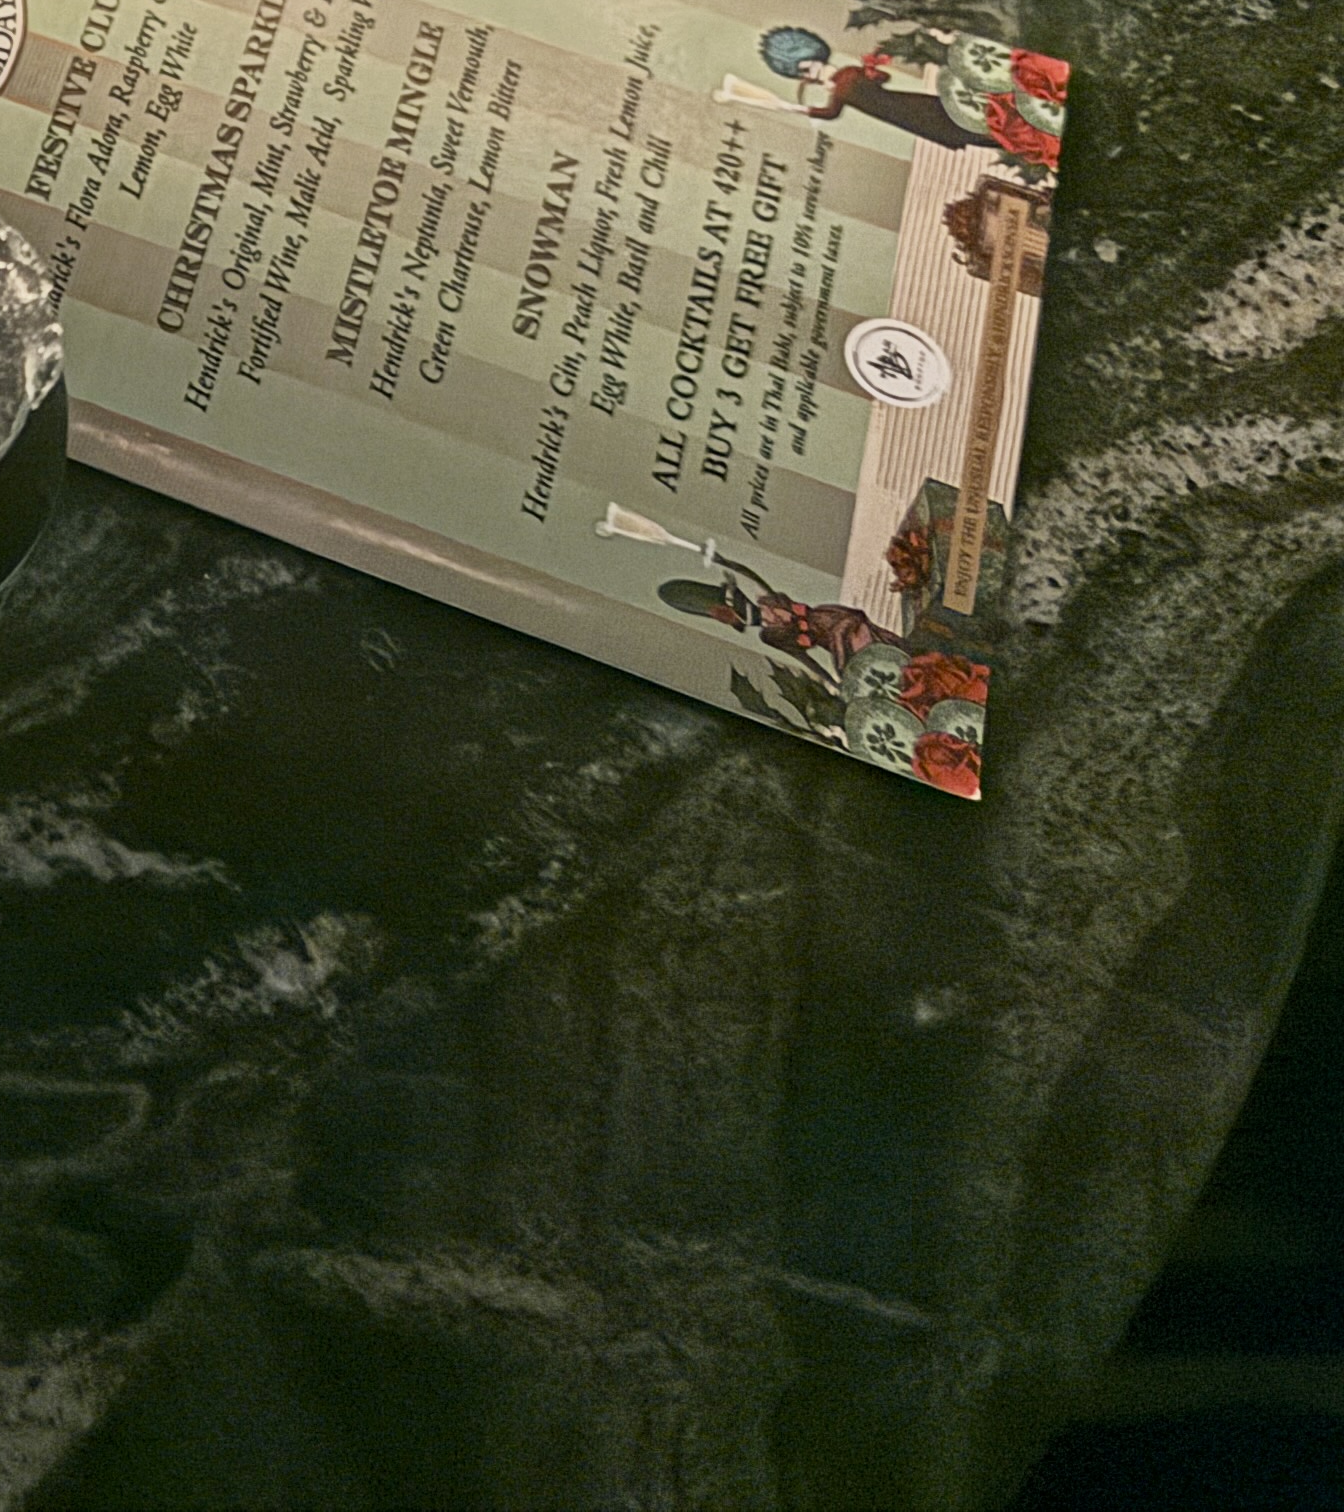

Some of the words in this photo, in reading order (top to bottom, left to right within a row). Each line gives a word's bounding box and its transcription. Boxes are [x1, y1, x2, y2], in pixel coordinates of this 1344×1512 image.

[302, 6, 327, 28] &
[107, 8, 167, 107] Raspberry
[157, 21, 198, 81] White
[321, 10, 376, 103] Sparkling
[444, 24, 495, 114] Vermouth,
[622, 23, 661, 81] Juice,
[143, 82, 184, 123] Egg
[268, 32, 328, 137] Strawberry
[486, 58, 523, 122] Bitters
[607, 75, 644, 142] Lemon
[23, 55, 97, 201] FESTIVE
[86, 112, 131, 176] Adora,
[304, 114, 343, 168] Acid,
[429, 116, 465, 177] Sweet
[711, 119, 747, 195] 420++
[805, 129, 834, 174] charge
[117, 128, 167, 200] Lemon,
[249, 142, 292, 198] Mint,
[466, 125, 506, 195] Lemon
[593, 146, 628, 203] Fresh
[751, 151, 787, 223] GIFT
[63, 176, 102, 231] Flora
[283, 167, 322, 228] Malic
[324, 155, 407, 368] MISTLETOE
[384, 20, 445, 155] MINGLE
[634, 191, 660, 235] and
[701, 198, 732, 245] AT
[801, 174, 822, 222] service
[155, 122, 244, 333] CHRISTMAS
[220, 201, 274, 291] Original,
[399, 182, 454, 282] Neptunia,
[436, 200, 492, 313] Chartreuse,
[511, 149, 580, 340] SNOWMAN
[575, 206, 620, 278] Liquor,
[790, 223, 814, 258] 10%
[821, 224, 844, 263] taxes.
[262, 233, 309, 294] Wine,
[616, 235, 651, 294] Basil
[735, 228, 773, 308] FREE
[789, 261, 807, 278] to
[560, 282, 597, 345] Peach
[665, 246, 724, 422] COCKTAILS
[779, 277, 804, 329] subject
[809, 263, 836, 351] government
[182, 297, 238, 413] Hendrick's
[235, 292, 283, 386] Fortified
[368, 284, 421, 400] Hendrick's
[418, 319, 456, 385] Green
[598, 301, 642, 370] White,
[720, 311, 756, 379] GET
[768, 332, 798, 372] Baht,
[548, 351, 587, 398] Gin,
[588, 372, 628, 417] Egg
[715, 387, 742, 406] 3
[760, 371, 786, 412] Thai
[793, 348, 821, 423] applicable
[700, 407, 738, 482] BUY
[758, 414, 779, 433] in
[758, 434, 775, 460] are
[786, 421, 808, 456] and
[520, 405, 569, 523] Hendrick's
[650, 431, 687, 493] ALL
[747, 462, 770, 512] prices
[739, 507, 761, 541] All
